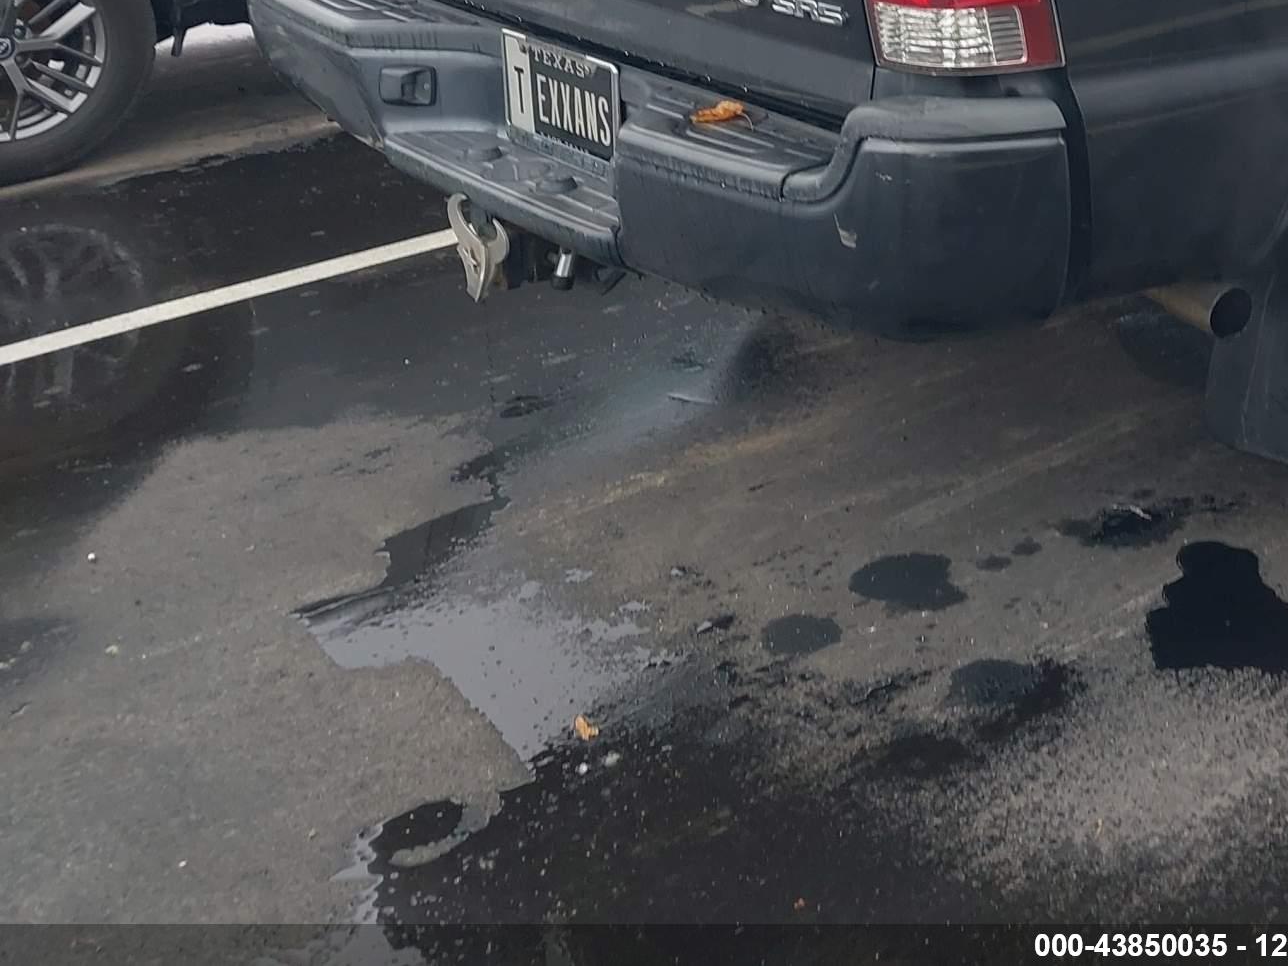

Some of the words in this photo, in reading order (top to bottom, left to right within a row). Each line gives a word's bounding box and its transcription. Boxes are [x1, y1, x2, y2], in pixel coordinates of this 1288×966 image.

[534, 47, 586, 79] TEXAS
[513, 65, 525, 114] T
[536, 73, 612, 147] EXXANS
